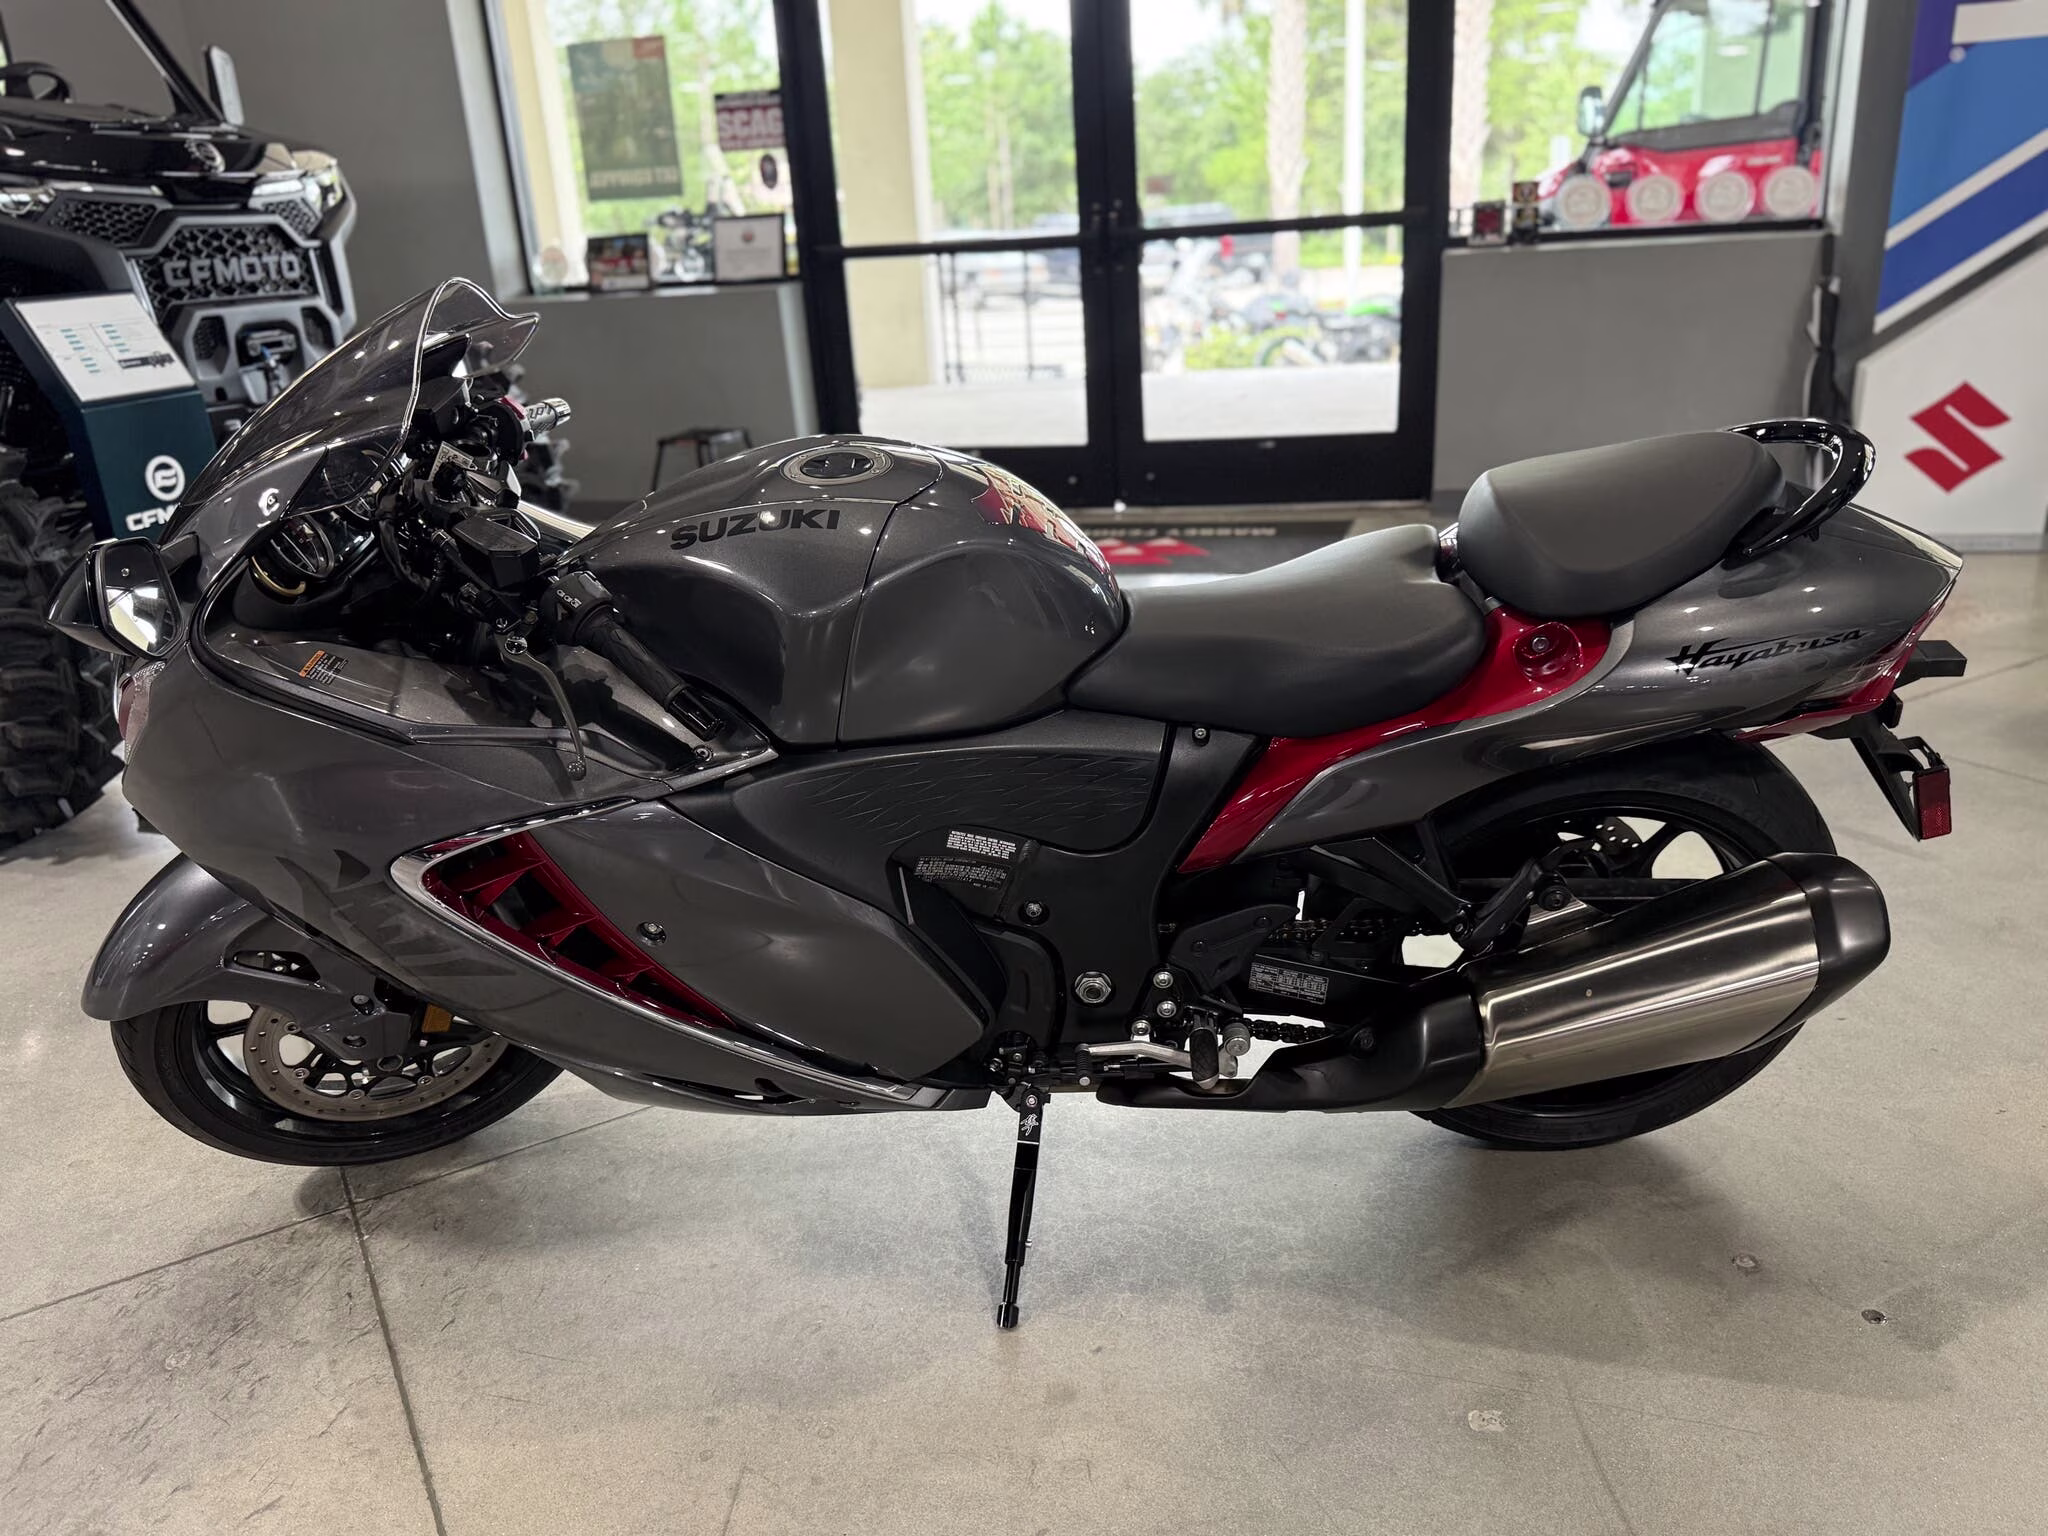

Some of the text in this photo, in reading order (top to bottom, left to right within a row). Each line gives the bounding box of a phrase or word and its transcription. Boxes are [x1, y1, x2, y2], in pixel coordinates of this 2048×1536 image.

[163, 252, 302, 288] CFMOTO
[126, 504, 177, 531] CFM
[670, 508, 841, 551] SUZUKI
[1664, 628, 1874, 675] Hayabusa
